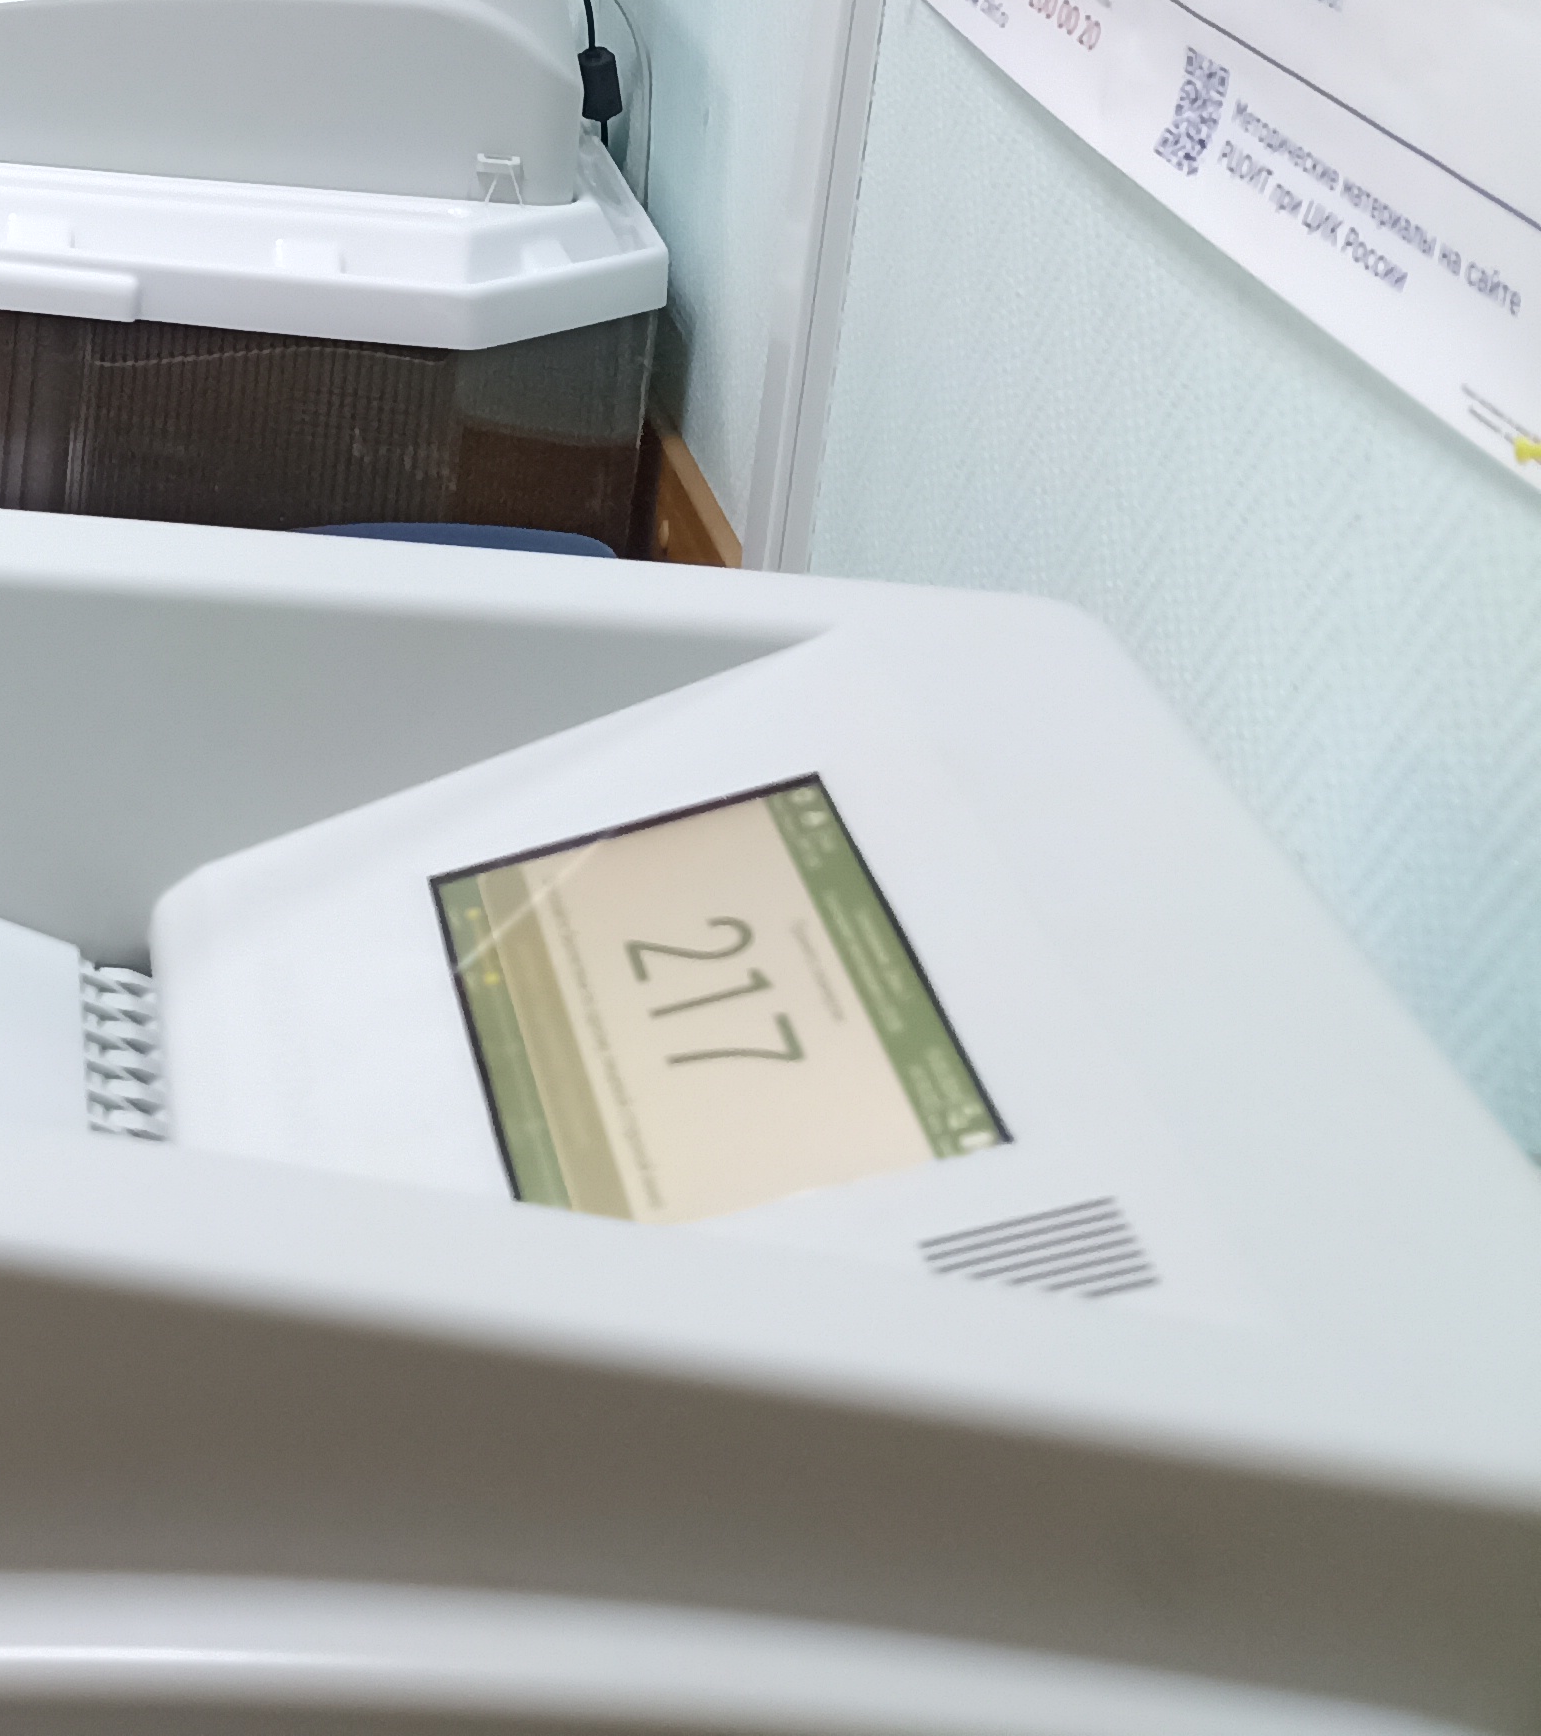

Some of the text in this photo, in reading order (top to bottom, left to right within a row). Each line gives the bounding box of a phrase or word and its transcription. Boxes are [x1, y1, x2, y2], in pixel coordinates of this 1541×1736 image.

[1056, 0, 1081, 36] 00
[1077, 14, 1102, 52] 20
[1267, 182, 1304, 219] при
[1339, 226, 1409, 293] России
[1437, 240, 1462, 276] на
[1464, 260, 1522, 316] сайте
[623, 914, 807, 1068] 217
